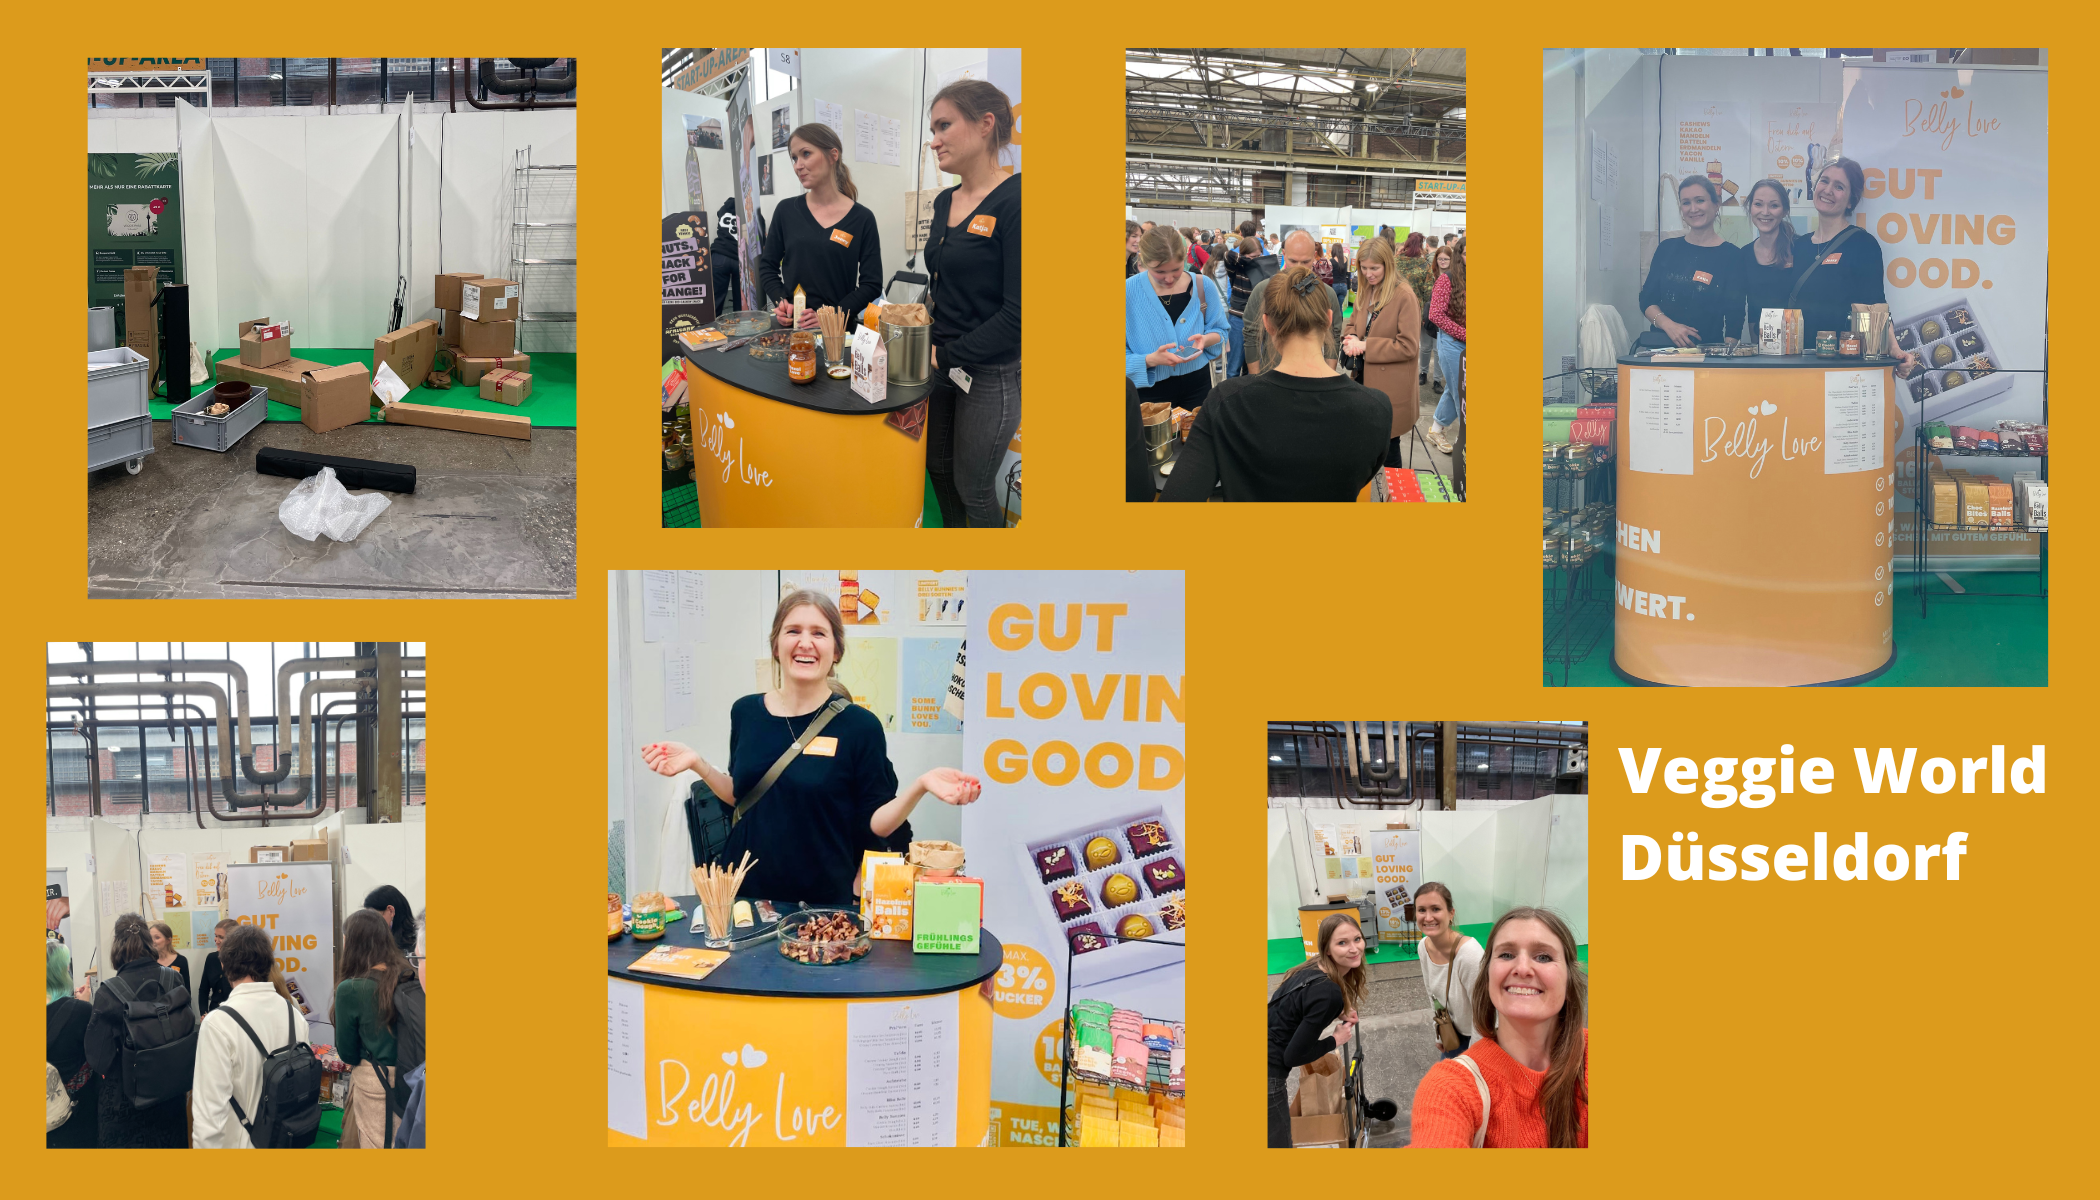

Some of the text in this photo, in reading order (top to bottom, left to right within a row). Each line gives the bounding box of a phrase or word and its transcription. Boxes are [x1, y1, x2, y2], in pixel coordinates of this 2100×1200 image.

[780, 52, 791, 64] S8
[1902, 98, 2001, 151] Belly Love
[1862, 167, 1943, 201] GUT
[971, 223, 989, 233] Katja
[663, 272, 687, 285] FOR
[1571, 418, 1608, 446] Belly
[699, 407, 773, 487] Belly Love
[1700, 416, 1775, 480] Belly
[1781, 416, 1823, 461] Love
[1932, 533, 1950, 542] MIT
[1952, 533, 1988, 542] GUTEM
[987, 602, 1129, 652] GUT
[985, 671, 1186, 724] LOVIN
[911, 705, 942, 713] BUNNY
[911, 713, 940, 721] LOVES
[983, 738, 1186, 792] GOOD
[1375, 854, 1396, 863] GUT
[1376, 864, 1414, 873] LOVING
[1377, 875, 1409, 884] GOOD.
[257, 878, 308, 905] Belly Love
[875, 898, 912, 906] Hazelnut
[875, 905, 910, 916] Balls
[916, 932, 974, 942] FRÜHLINGS
[916, 942, 962, 951] GEFÜHLE
[1002, 951, 1030, 962] MAX.
[997, 963, 1047, 991] 3%
[656, 1059, 764, 1147] Belly
[775, 1072, 843, 1142] Love
[1010, 1116, 1044, 1133] TUE,
